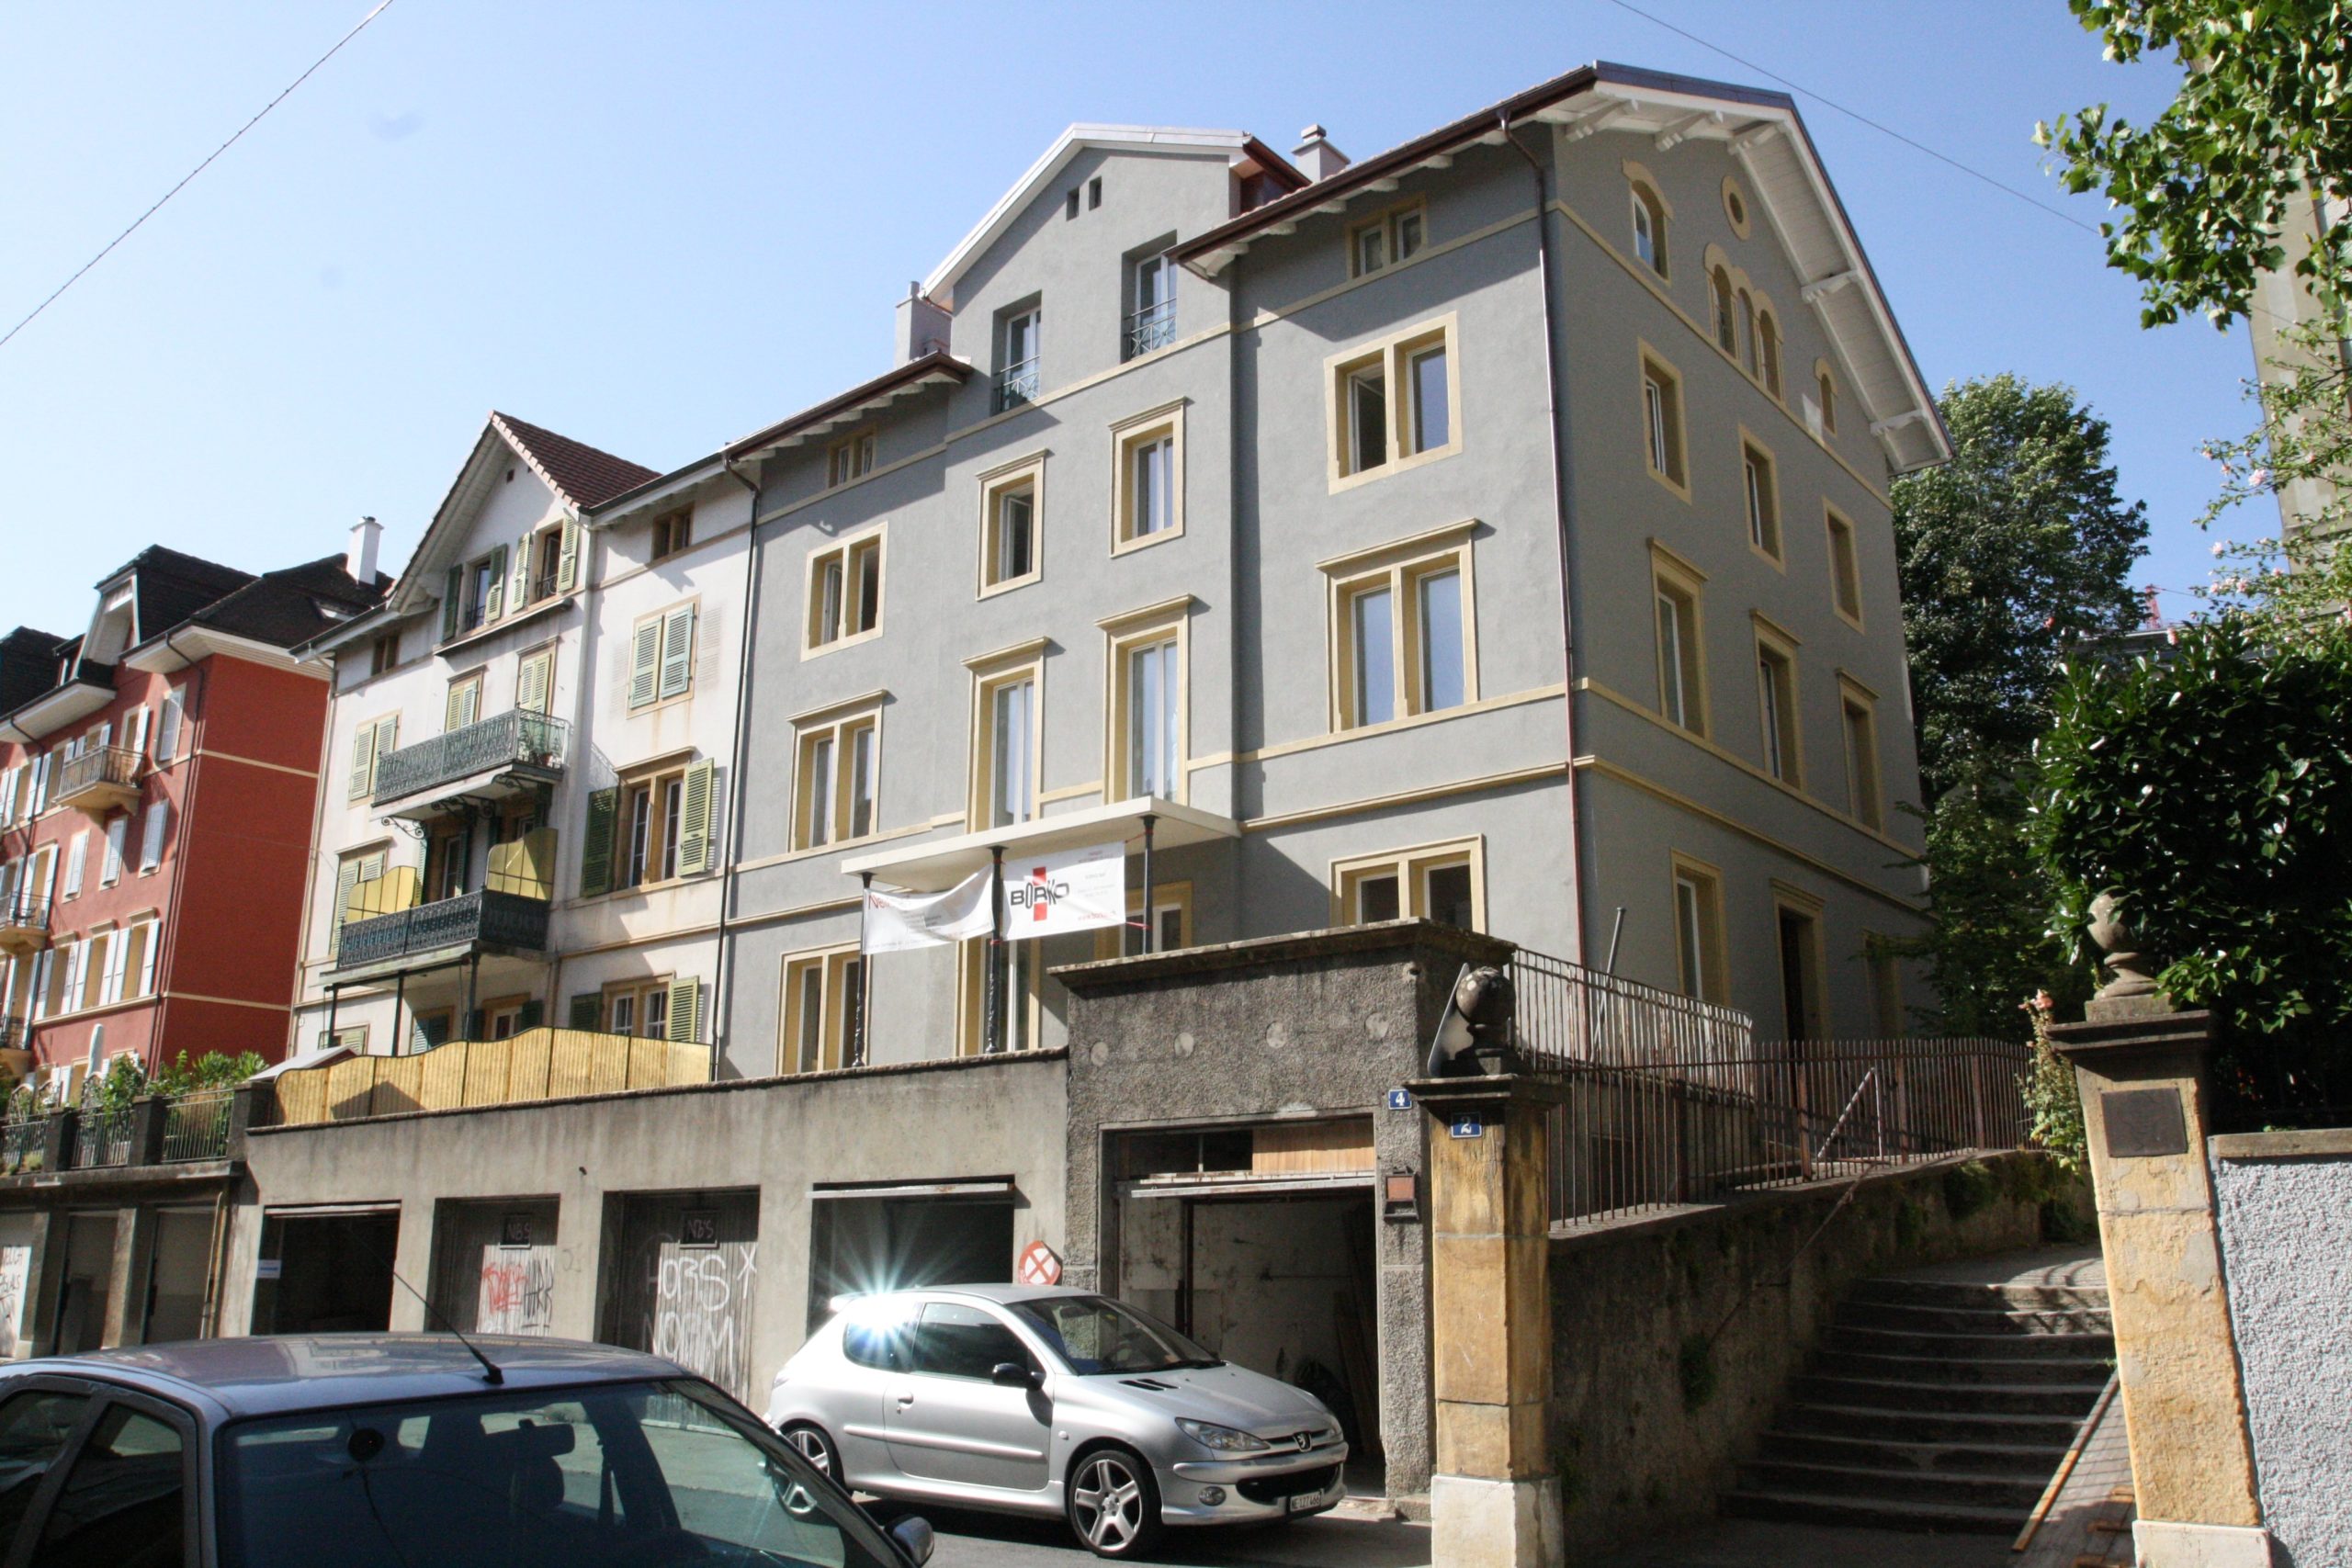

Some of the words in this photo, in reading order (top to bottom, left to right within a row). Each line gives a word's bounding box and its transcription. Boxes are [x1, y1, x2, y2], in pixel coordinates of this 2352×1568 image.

[1396, 1091, 1405, 1106] 4
[1461, 1116, 1472, 1134] 2
[646, 1254, 729, 1311] HORS
